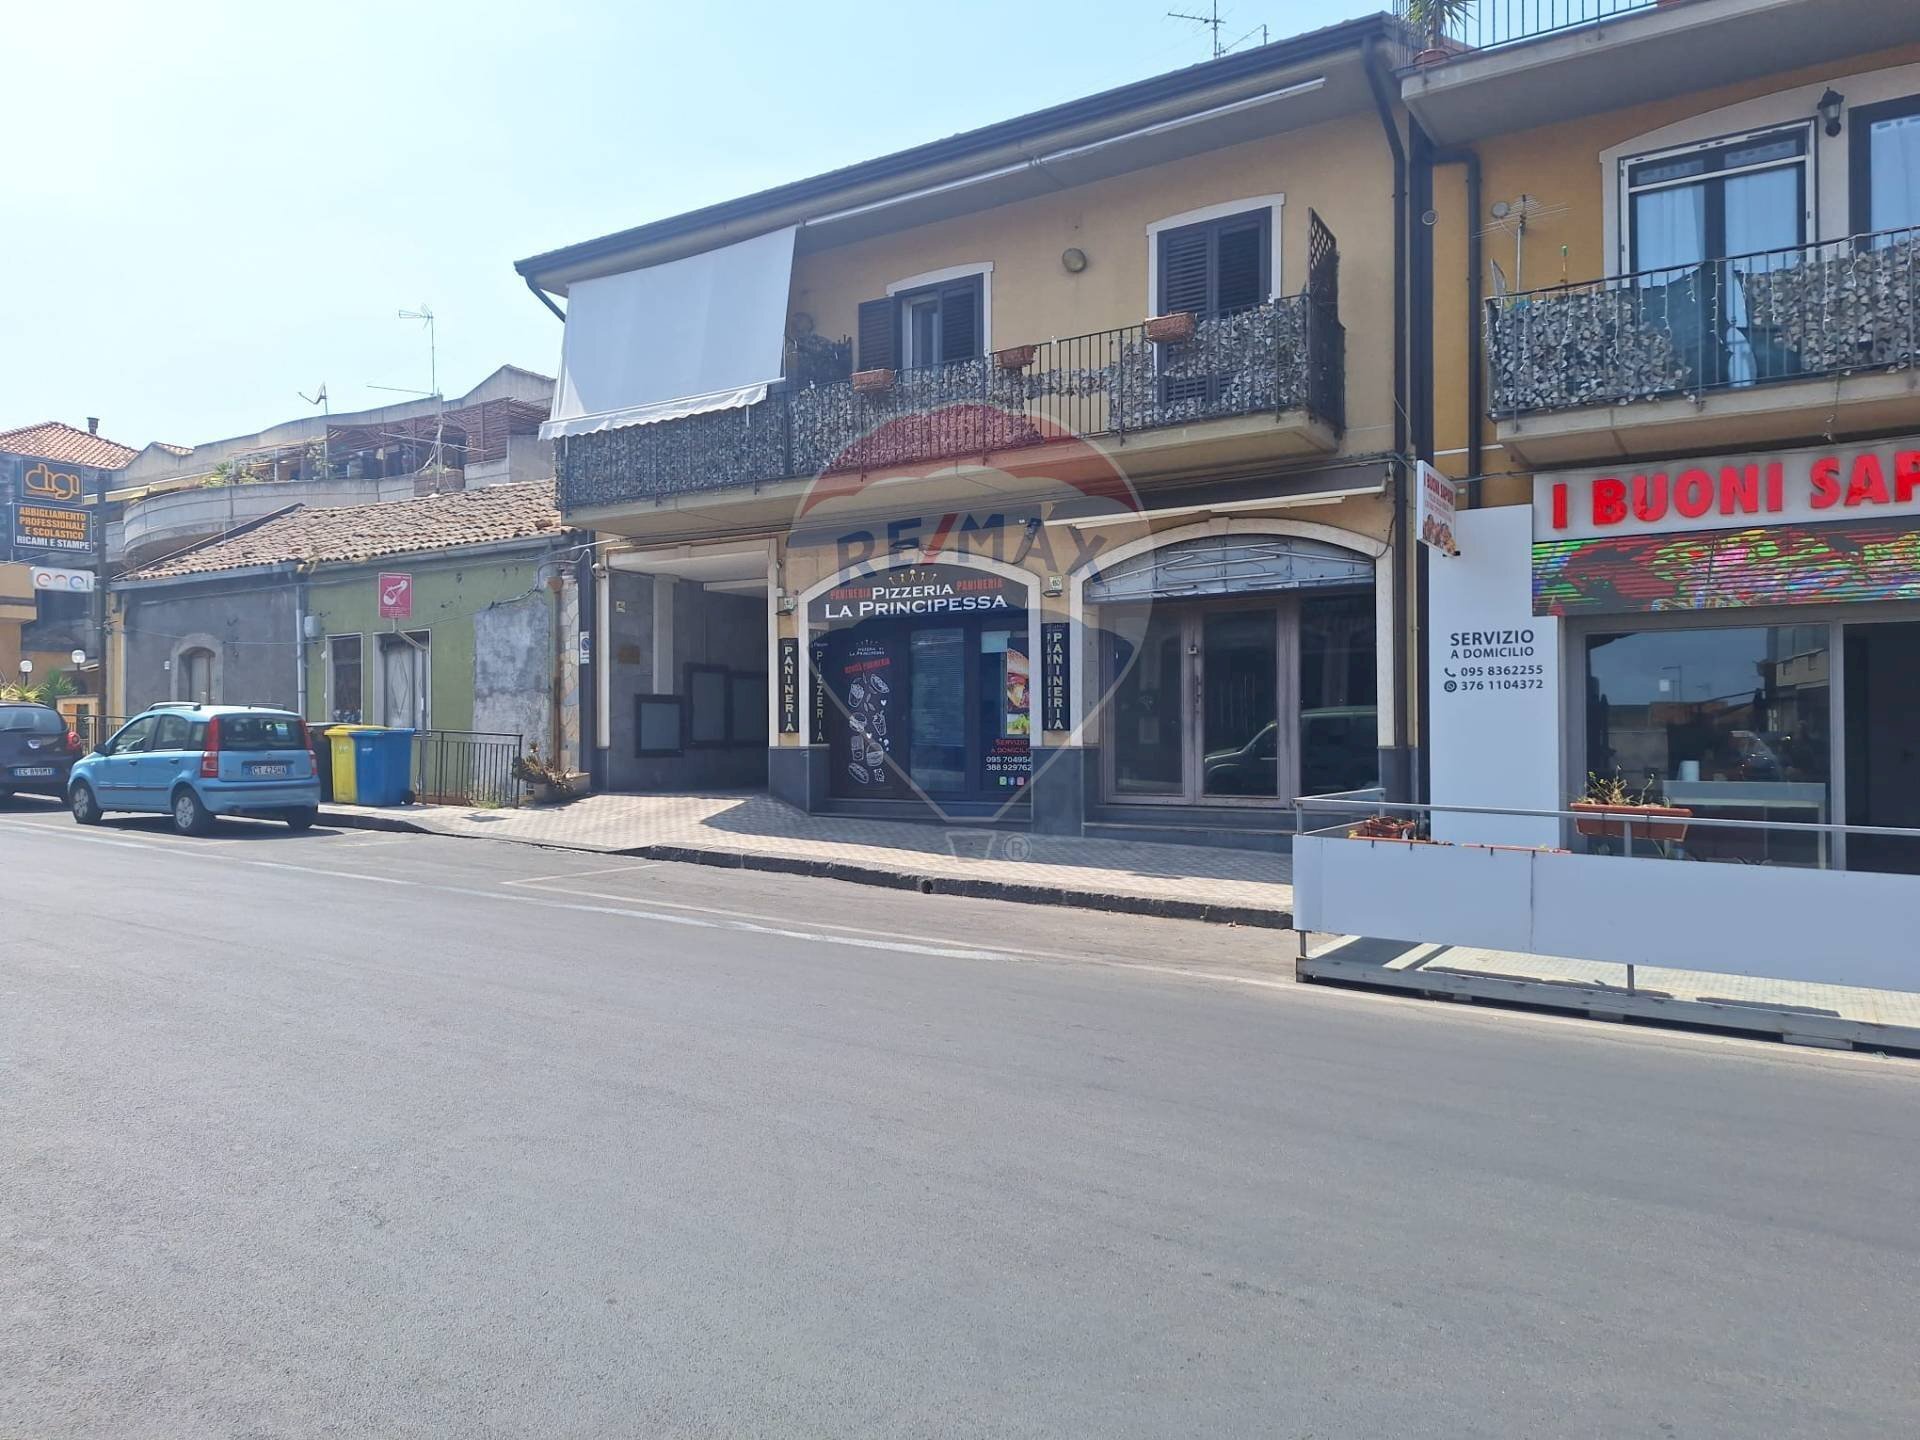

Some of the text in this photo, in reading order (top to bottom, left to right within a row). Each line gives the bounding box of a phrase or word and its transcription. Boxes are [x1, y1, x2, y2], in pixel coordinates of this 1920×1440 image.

[1553, 483, 1568, 529] I
[1592, 461, 1783, 526] BUONI
[19, 506, 86, 521] ABBIGLIAMENTO
[19, 516, 86, 531] PROFESSIONALE
[25, 526, 84, 540] E SCOLASTICO
[16, 535, 90, 550] RICAMI E STAMPE
[872, 583, 954, 600] PIZZERIA
[825, 595, 1008, 619] LA PRINCIPESSA
[1450, 629, 1534, 646] SERVIZIO
[1451, 646, 1534, 659] A DOMICILIO
[1461, 665, 1543, 676] 095 8362255
[1053, 632, 1063, 729] PANINERIA
[1461, 679, 1543, 690] 376 1104372
[784, 646, 794, 731] PANINERIA
